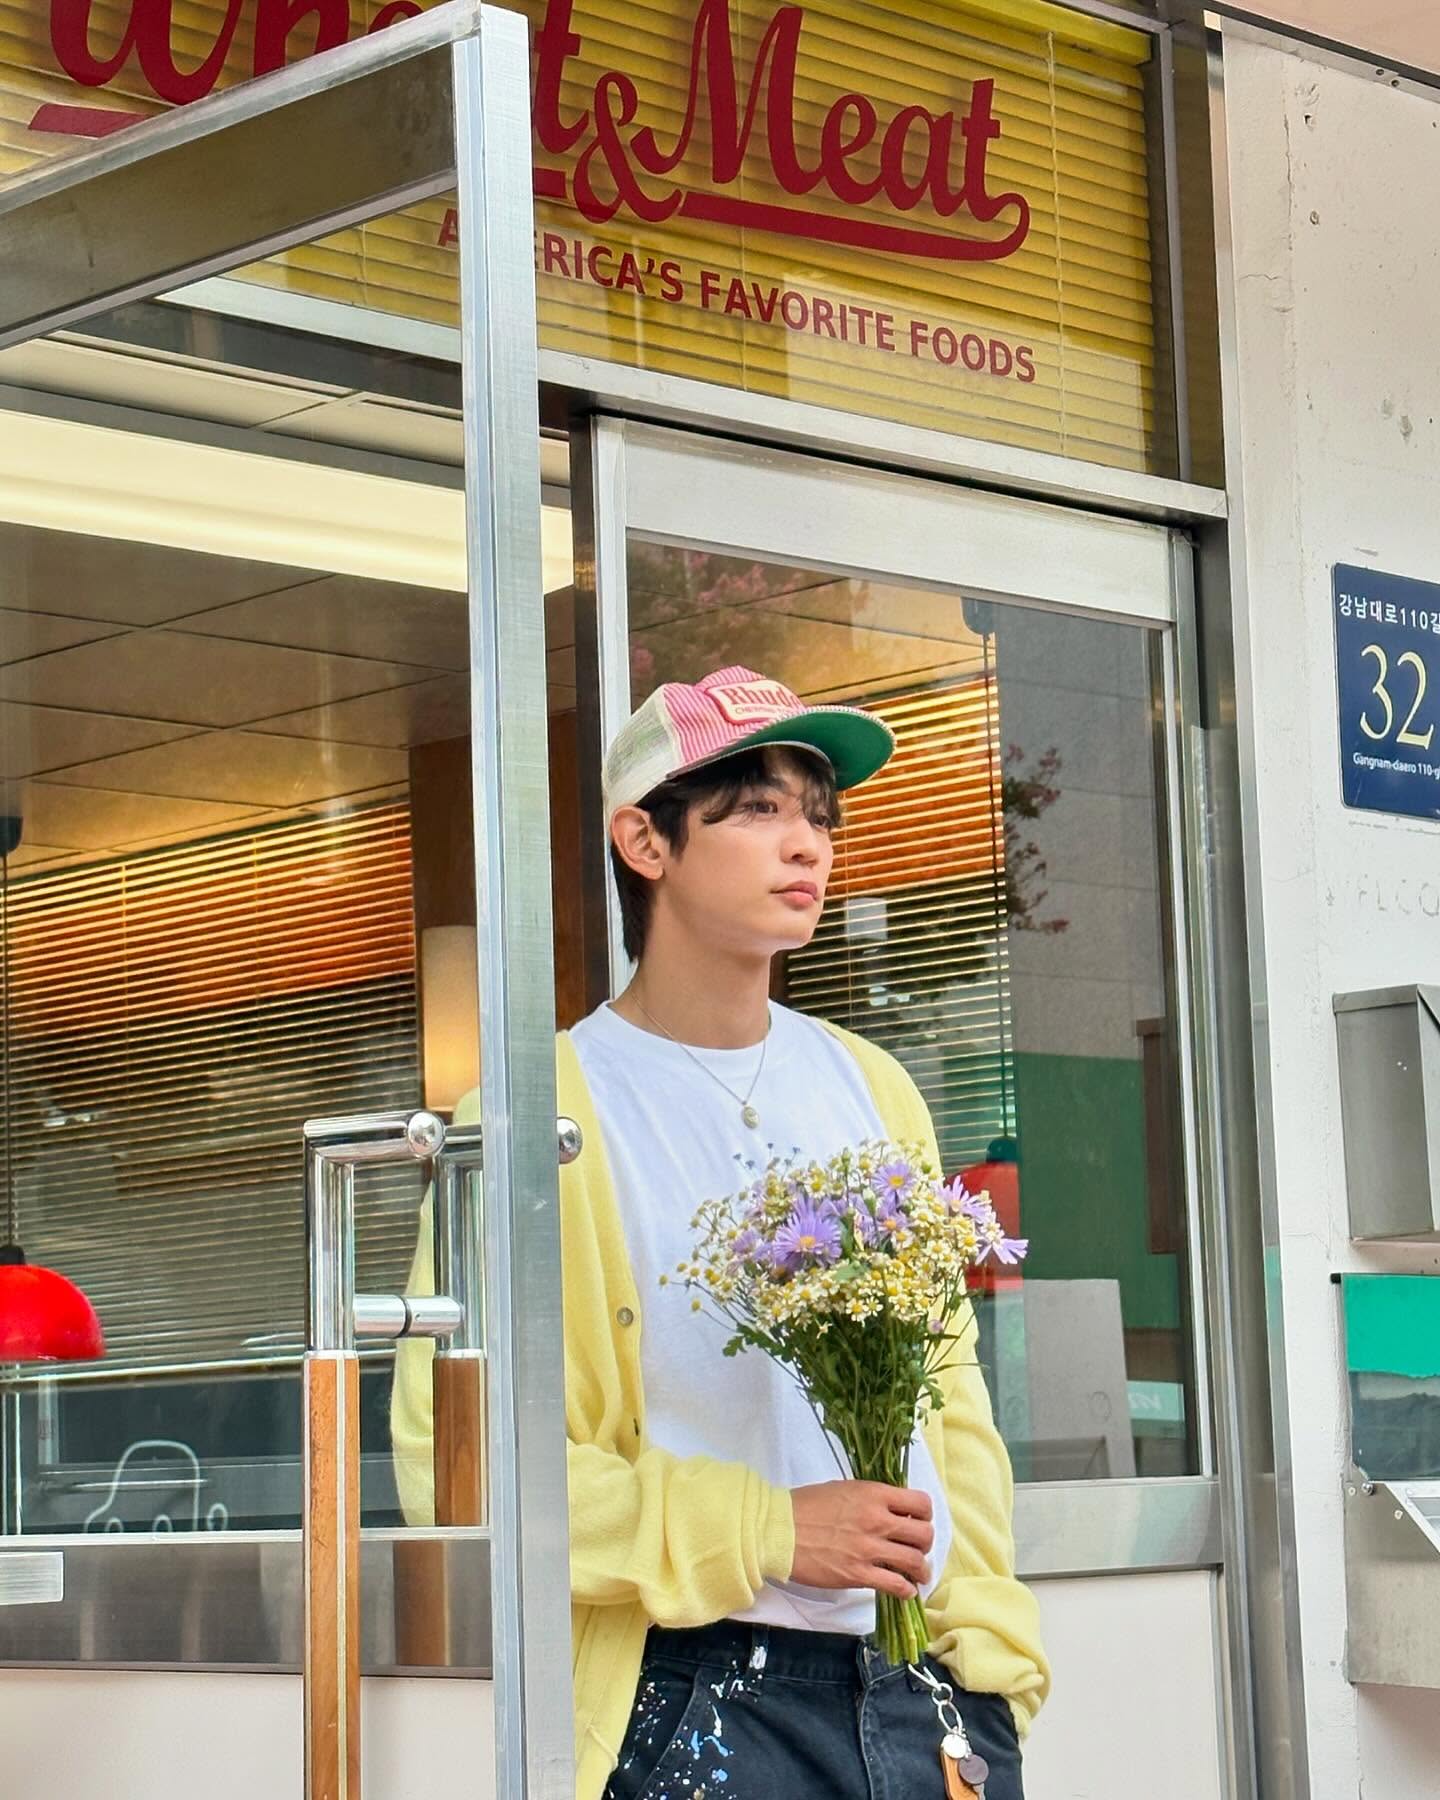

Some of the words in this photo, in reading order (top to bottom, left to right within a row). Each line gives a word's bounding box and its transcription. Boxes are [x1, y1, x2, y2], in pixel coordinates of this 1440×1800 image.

[573, 72, 683, 224] &
[630, 0, 1030, 222] Meat
[437, 208, 684, 303] ARICA'S
[700, 271, 896, 352] FAVORITE
[910, 321, 1036, 383] FOODS
[1353, 752, 1416, 774] Gangnam-daero
[1418, 762, 1440, 780] 110-g
[1360, 644, 1434, 750] 32
